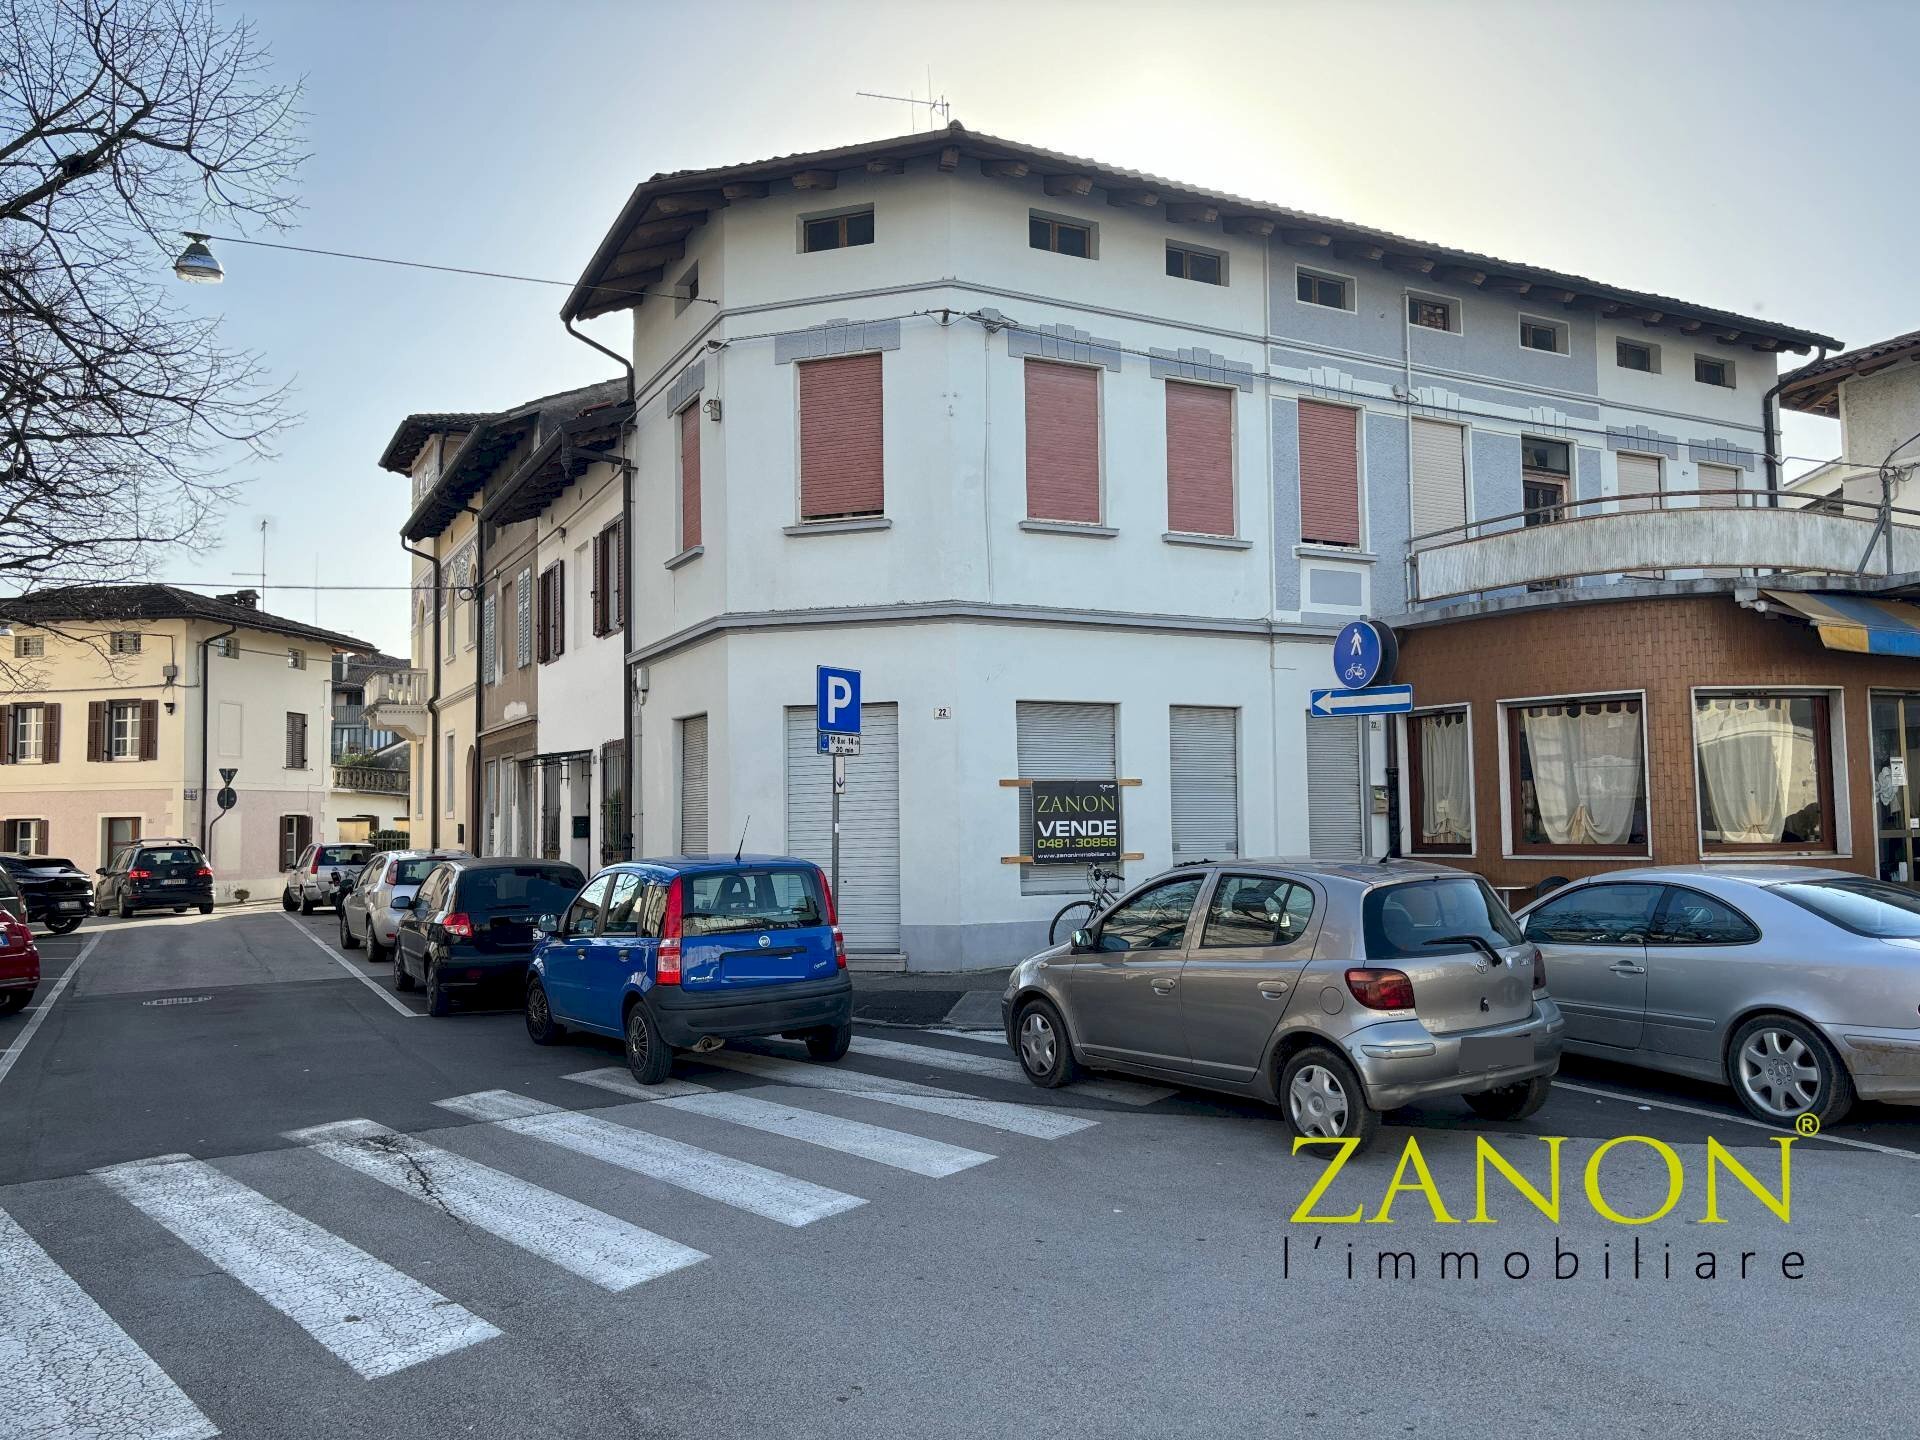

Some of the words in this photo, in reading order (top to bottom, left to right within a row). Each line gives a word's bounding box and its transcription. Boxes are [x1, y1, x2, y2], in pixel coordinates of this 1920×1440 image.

[827, 675, 852, 724] P
[938, 708, 947, 717] 22
[1037, 795, 1115, 813] ZANON
[1037, 820, 1117, 837] VENDE
[1037, 837, 1117, 849] 0481.30858
